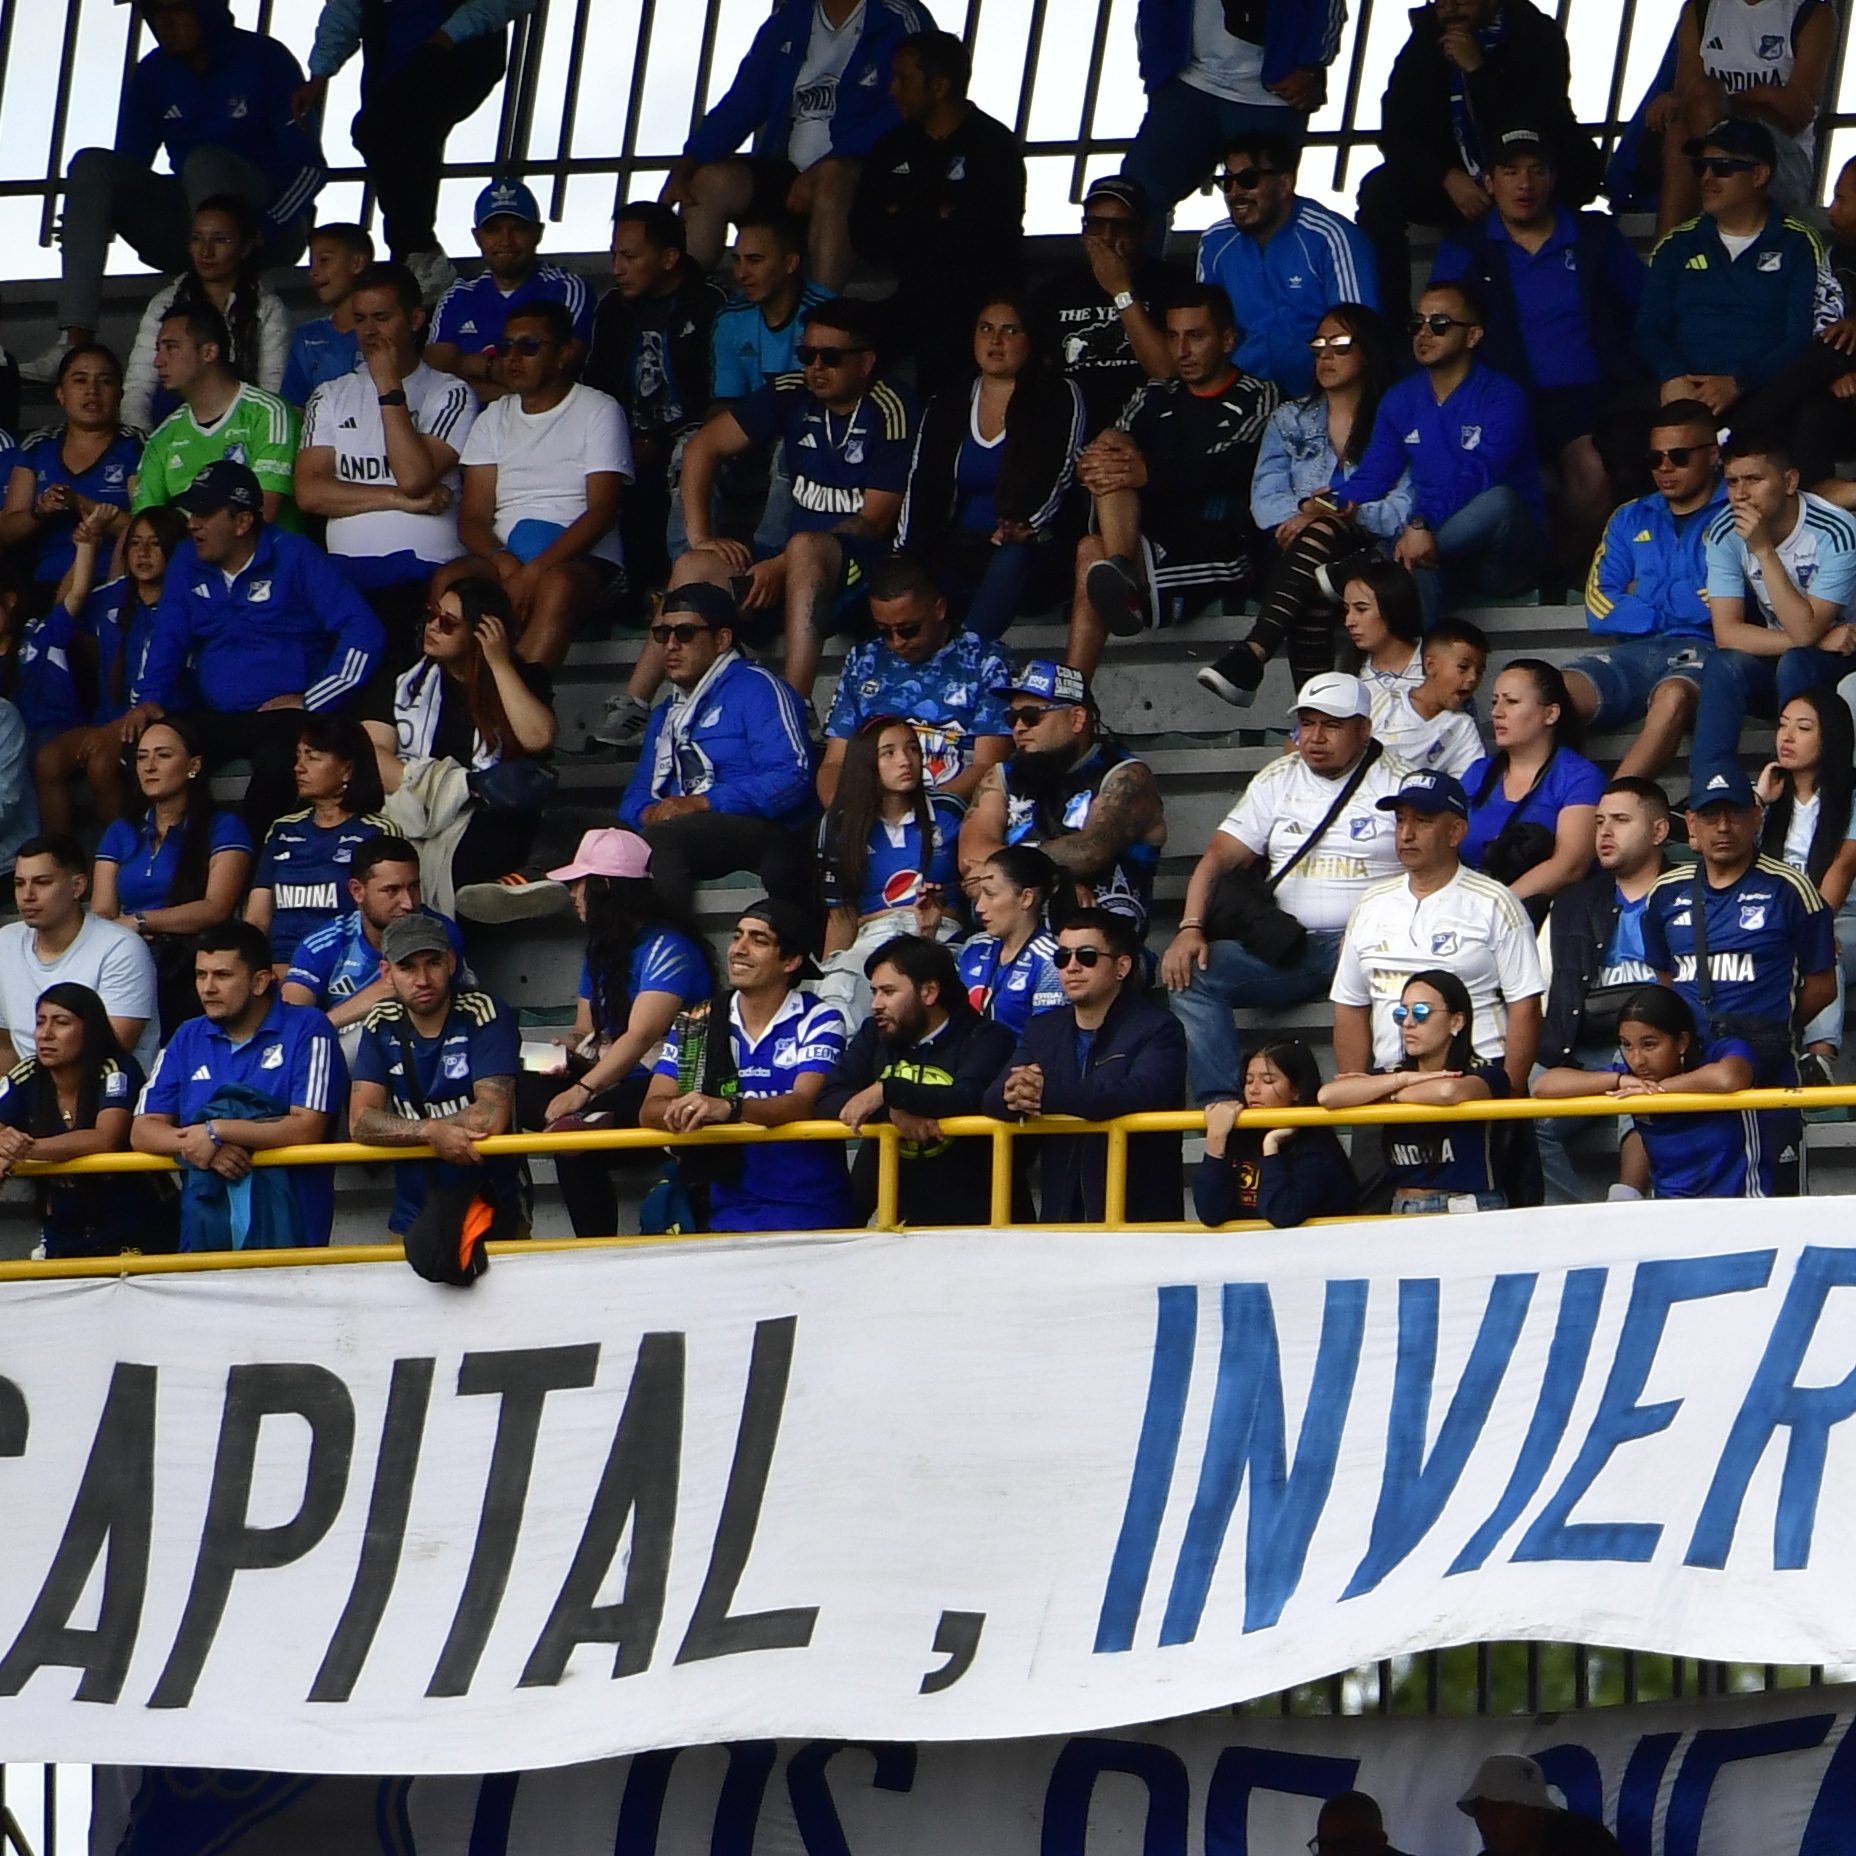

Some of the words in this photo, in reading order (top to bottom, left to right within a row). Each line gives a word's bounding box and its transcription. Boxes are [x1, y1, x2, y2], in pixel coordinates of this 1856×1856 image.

[795, 474, 865, 513] ANDINA
[275, 883, 339, 909] ANDINA
[1673, 952, 1755, 983] ANINA
[806, 1044, 842, 1066] LEON
